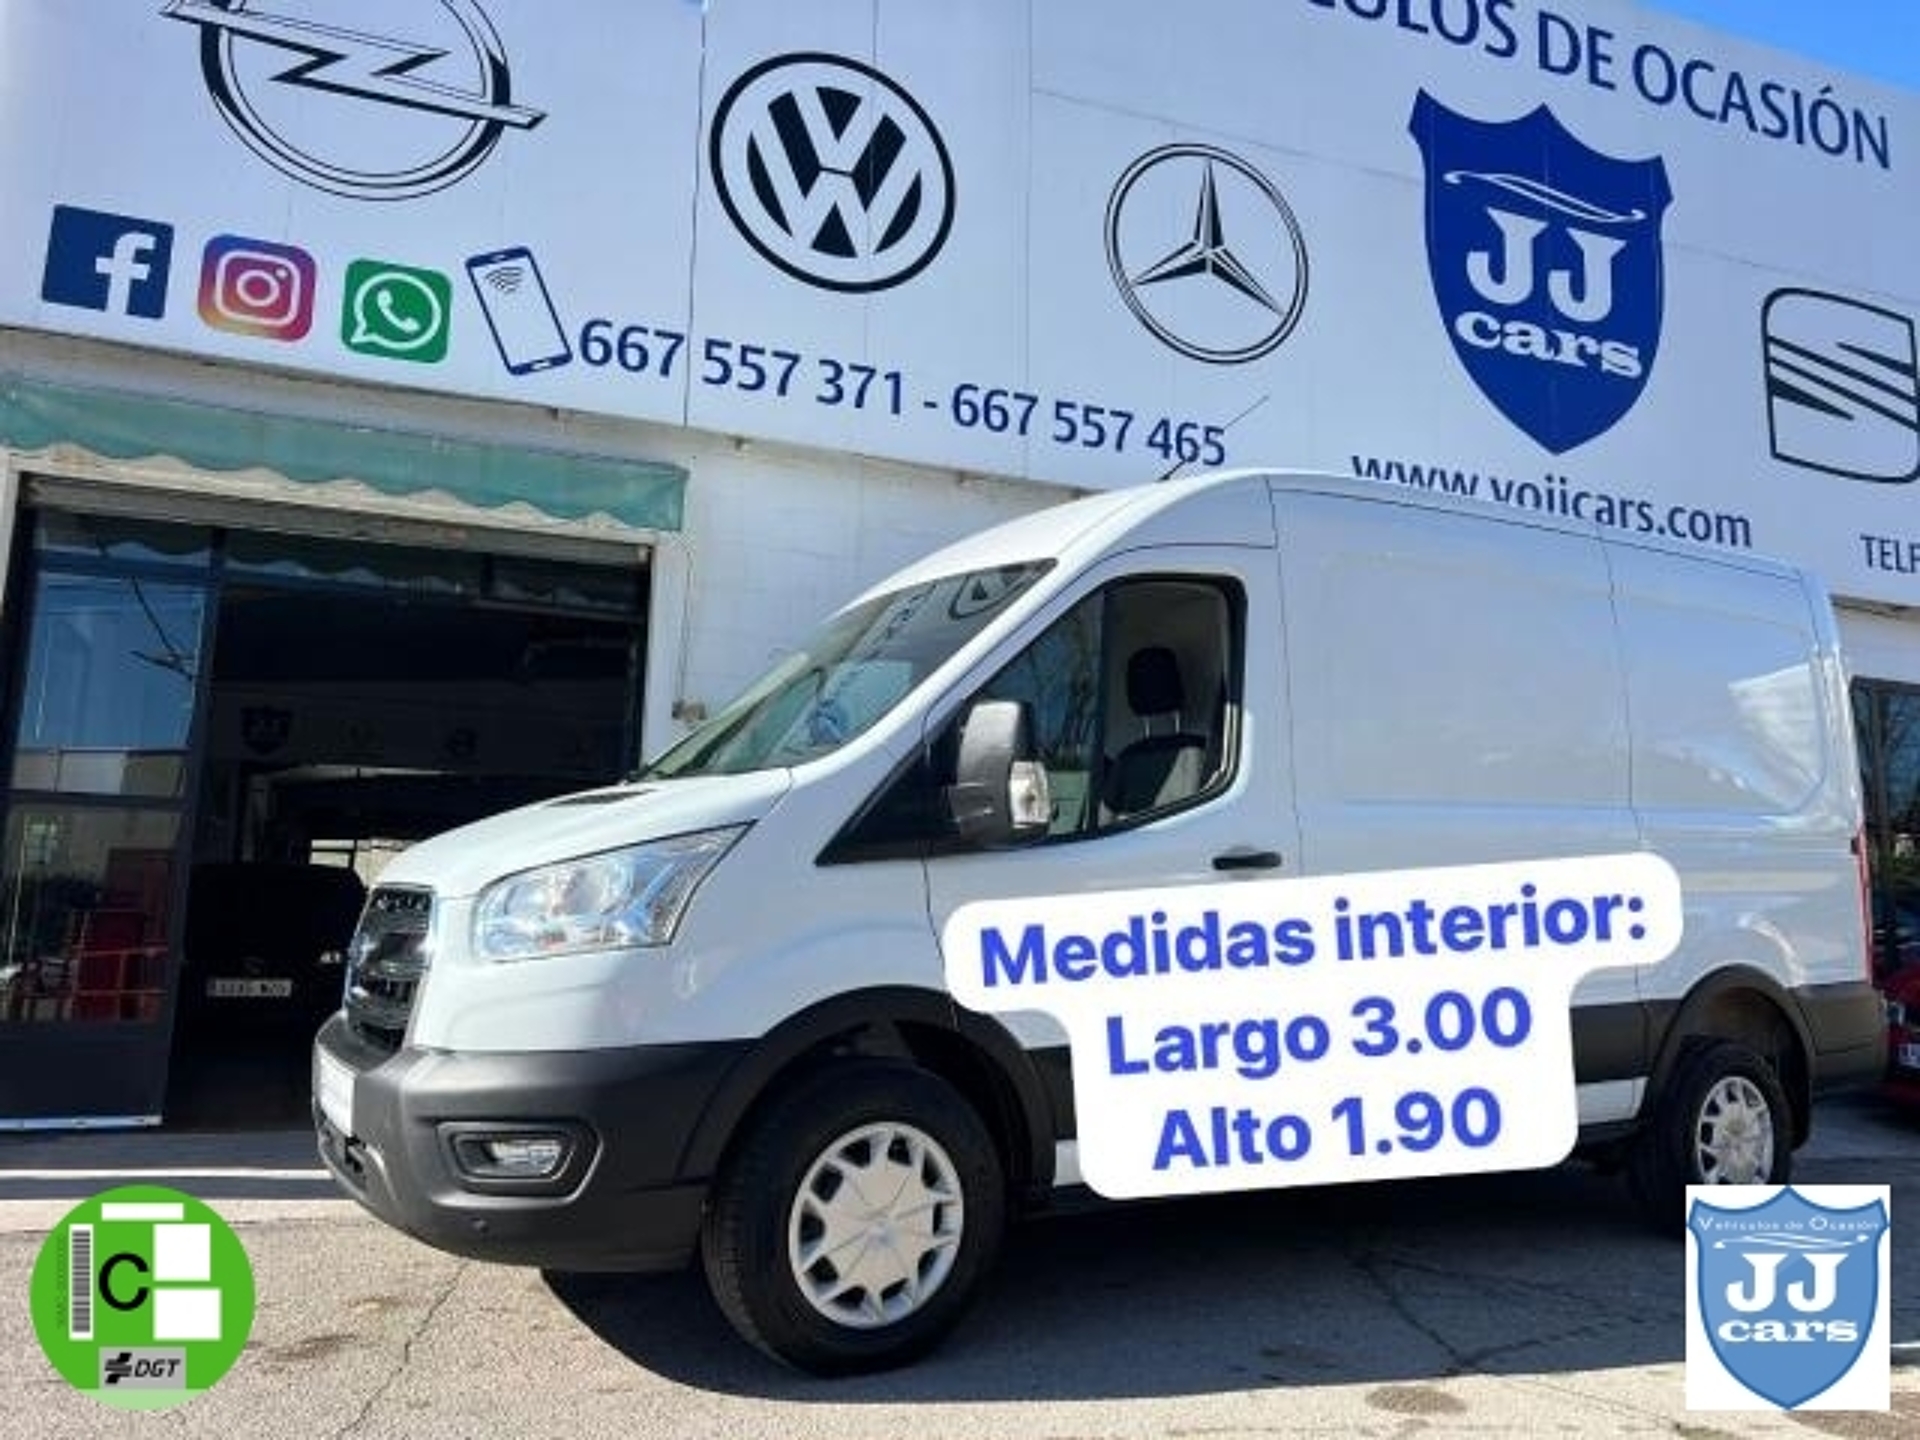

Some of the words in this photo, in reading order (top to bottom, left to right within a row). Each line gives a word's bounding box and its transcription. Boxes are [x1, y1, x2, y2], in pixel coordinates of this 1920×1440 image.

[1538, 11, 1616, 90] DE
[1632, 43, 1890, 169] OCASIÓN
[1466, 206, 1627, 322] JJ
[579, 319, 685, 378] 667
[701, 338, 801, 397] 557
[817, 358, 902, 416] 371
[952, 384, 1039, 437] 667
[1053, 401, 1133, 452] 557
[1147, 418, 1226, 467] 465
[1454, 311, 1642, 378] cars
